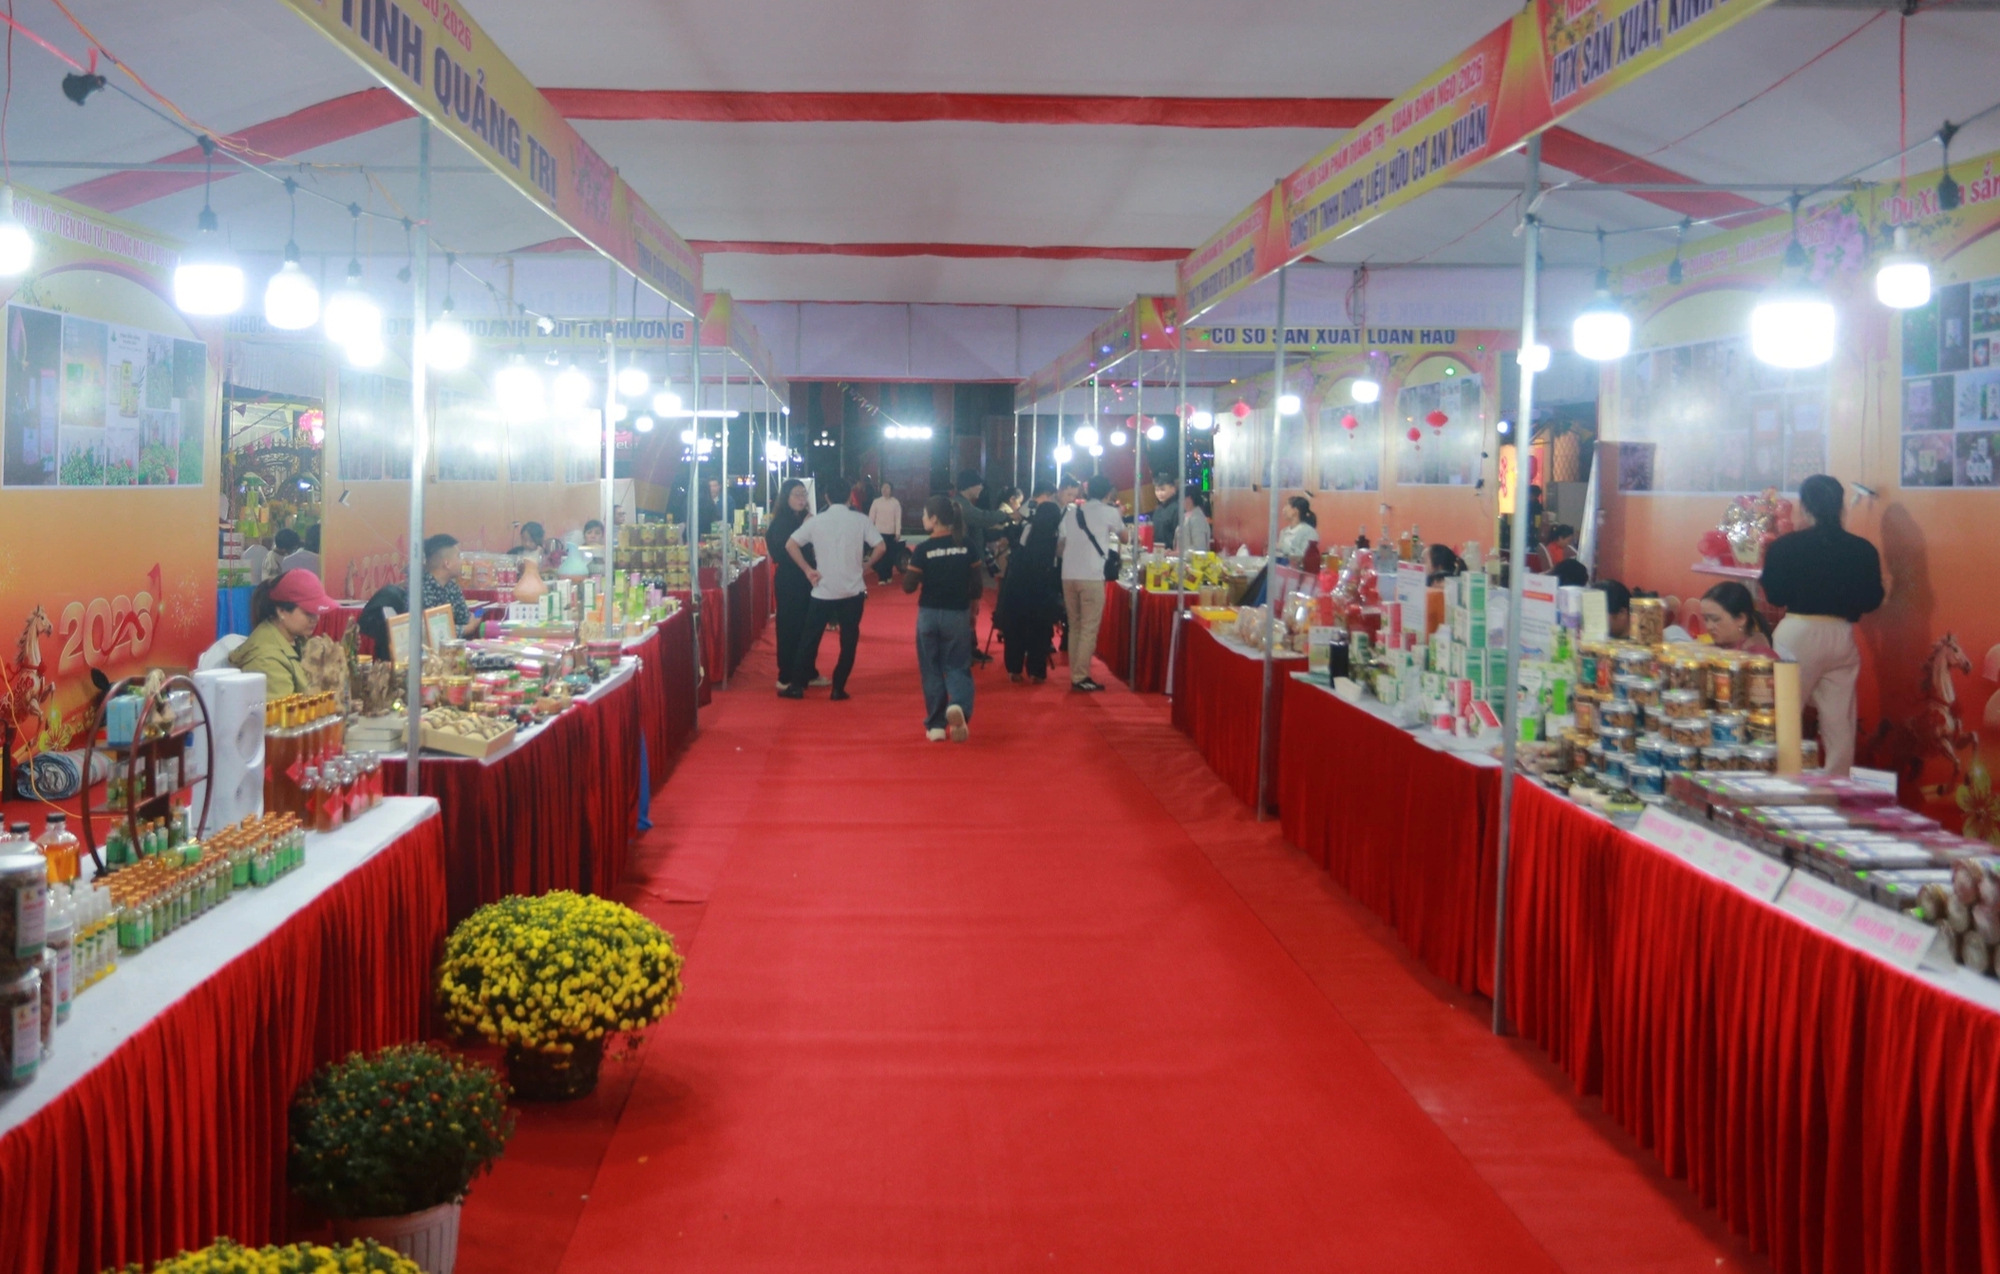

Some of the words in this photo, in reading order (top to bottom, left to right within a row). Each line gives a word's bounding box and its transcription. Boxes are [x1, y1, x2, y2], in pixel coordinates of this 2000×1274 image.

[443, 4, 472, 52] 2026
[1552, 43, 1579, 104] HTX
[1582, 13, 1614, 86] SẢN
[434, 47, 520, 171] QUẢNG
[527, 134, 557, 210] TRỊ
[1391, 101, 1413, 137] XUÂN
[1436, 74, 1456, 106] NGỌ
[1458, 54, 1485, 94] 2026
[1366, 161, 1387, 211] LIỆU
[1388, 146, 1410, 193] HỮU
[1412, 135, 1428, 182] CƠ
[1430, 128, 1447, 173] AN
[1450, 102, 1489, 162] XUÂN
[21, 197, 39, 227] TÂM
[41, 205, 57, 233] XÚC
[59, 210, 76, 239] TIẾN
[77, 215, 92, 244] ĐẦU
[616, 320, 684, 340] HƯƠNG
[1367, 329, 1413, 344] LOAN
[58, 591, 154, 673] 2026
